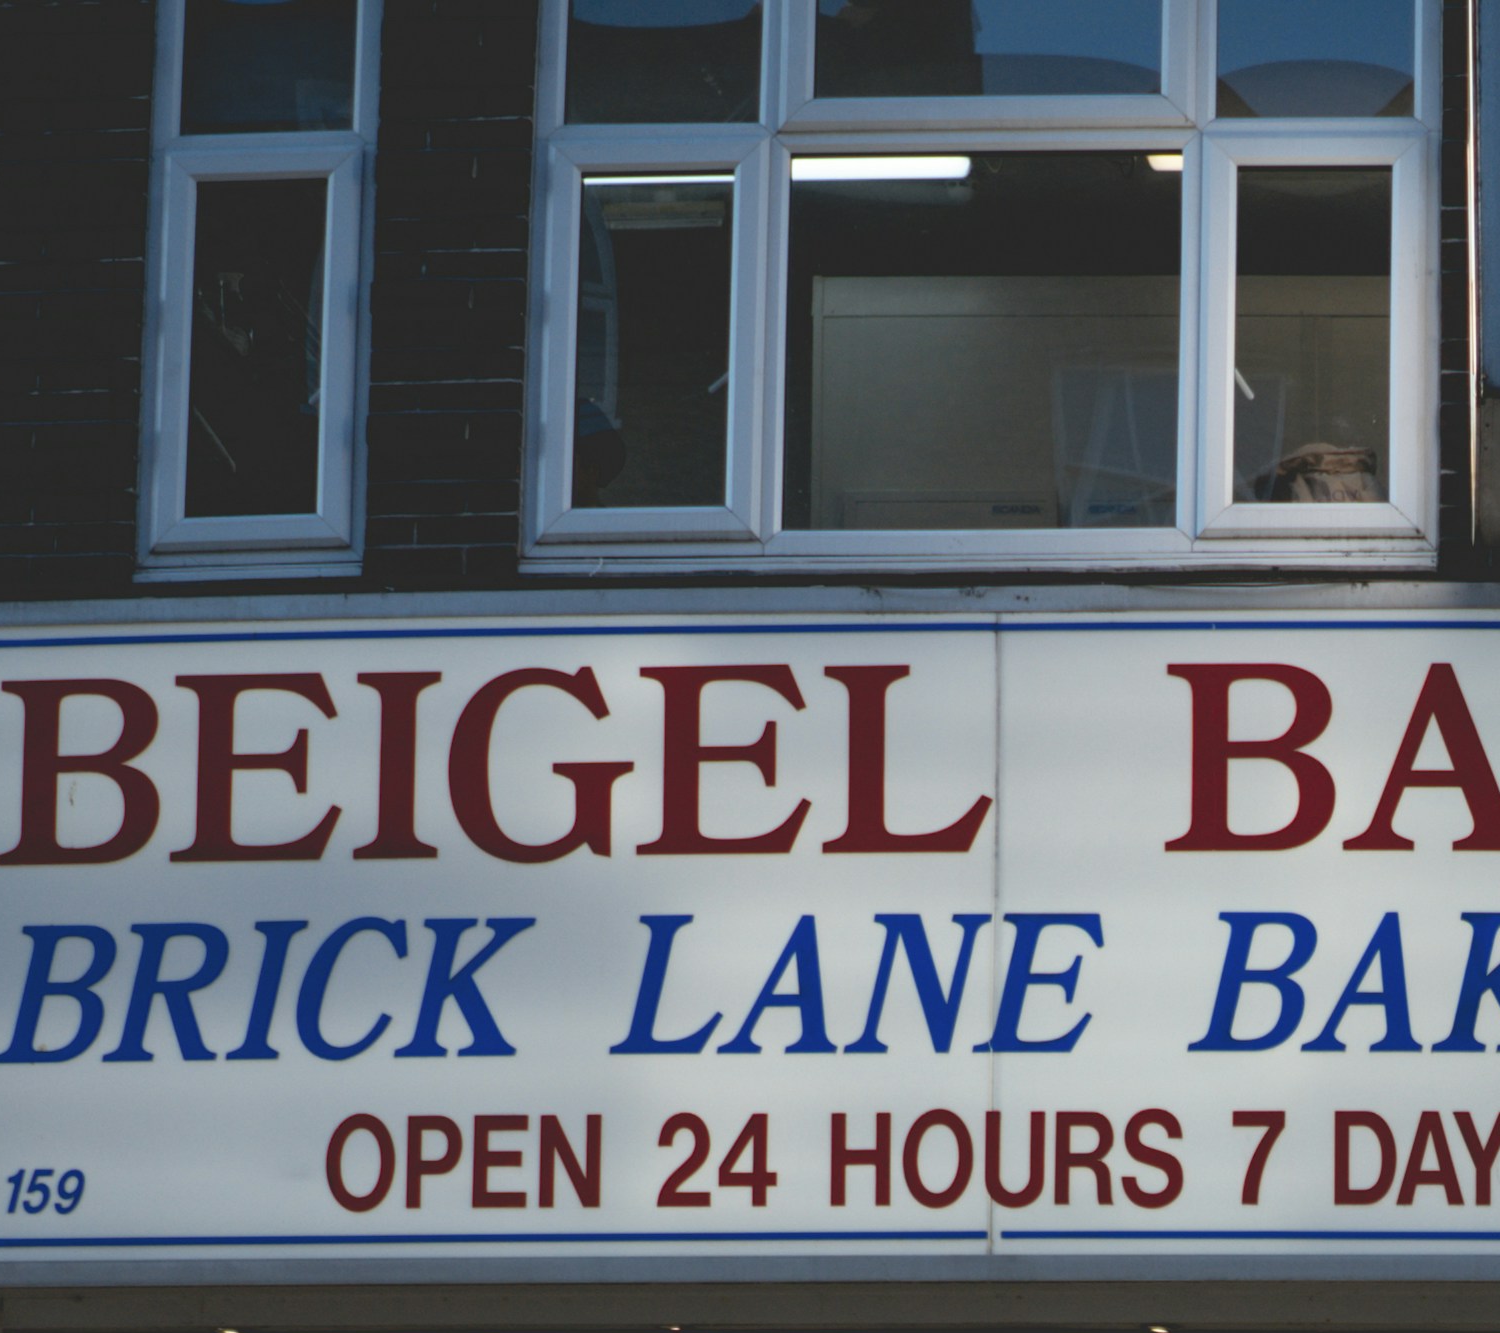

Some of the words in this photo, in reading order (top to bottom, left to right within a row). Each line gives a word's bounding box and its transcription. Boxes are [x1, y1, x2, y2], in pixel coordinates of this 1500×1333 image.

[609, 913, 1105, 1055] LANE
[325, 1112, 603, 1213] OPEN
[656, 1112, 778, 1208] 24
[830, 1108, 1185, 1209] HOURS
[1231, 1110, 1286, 1206] 7
